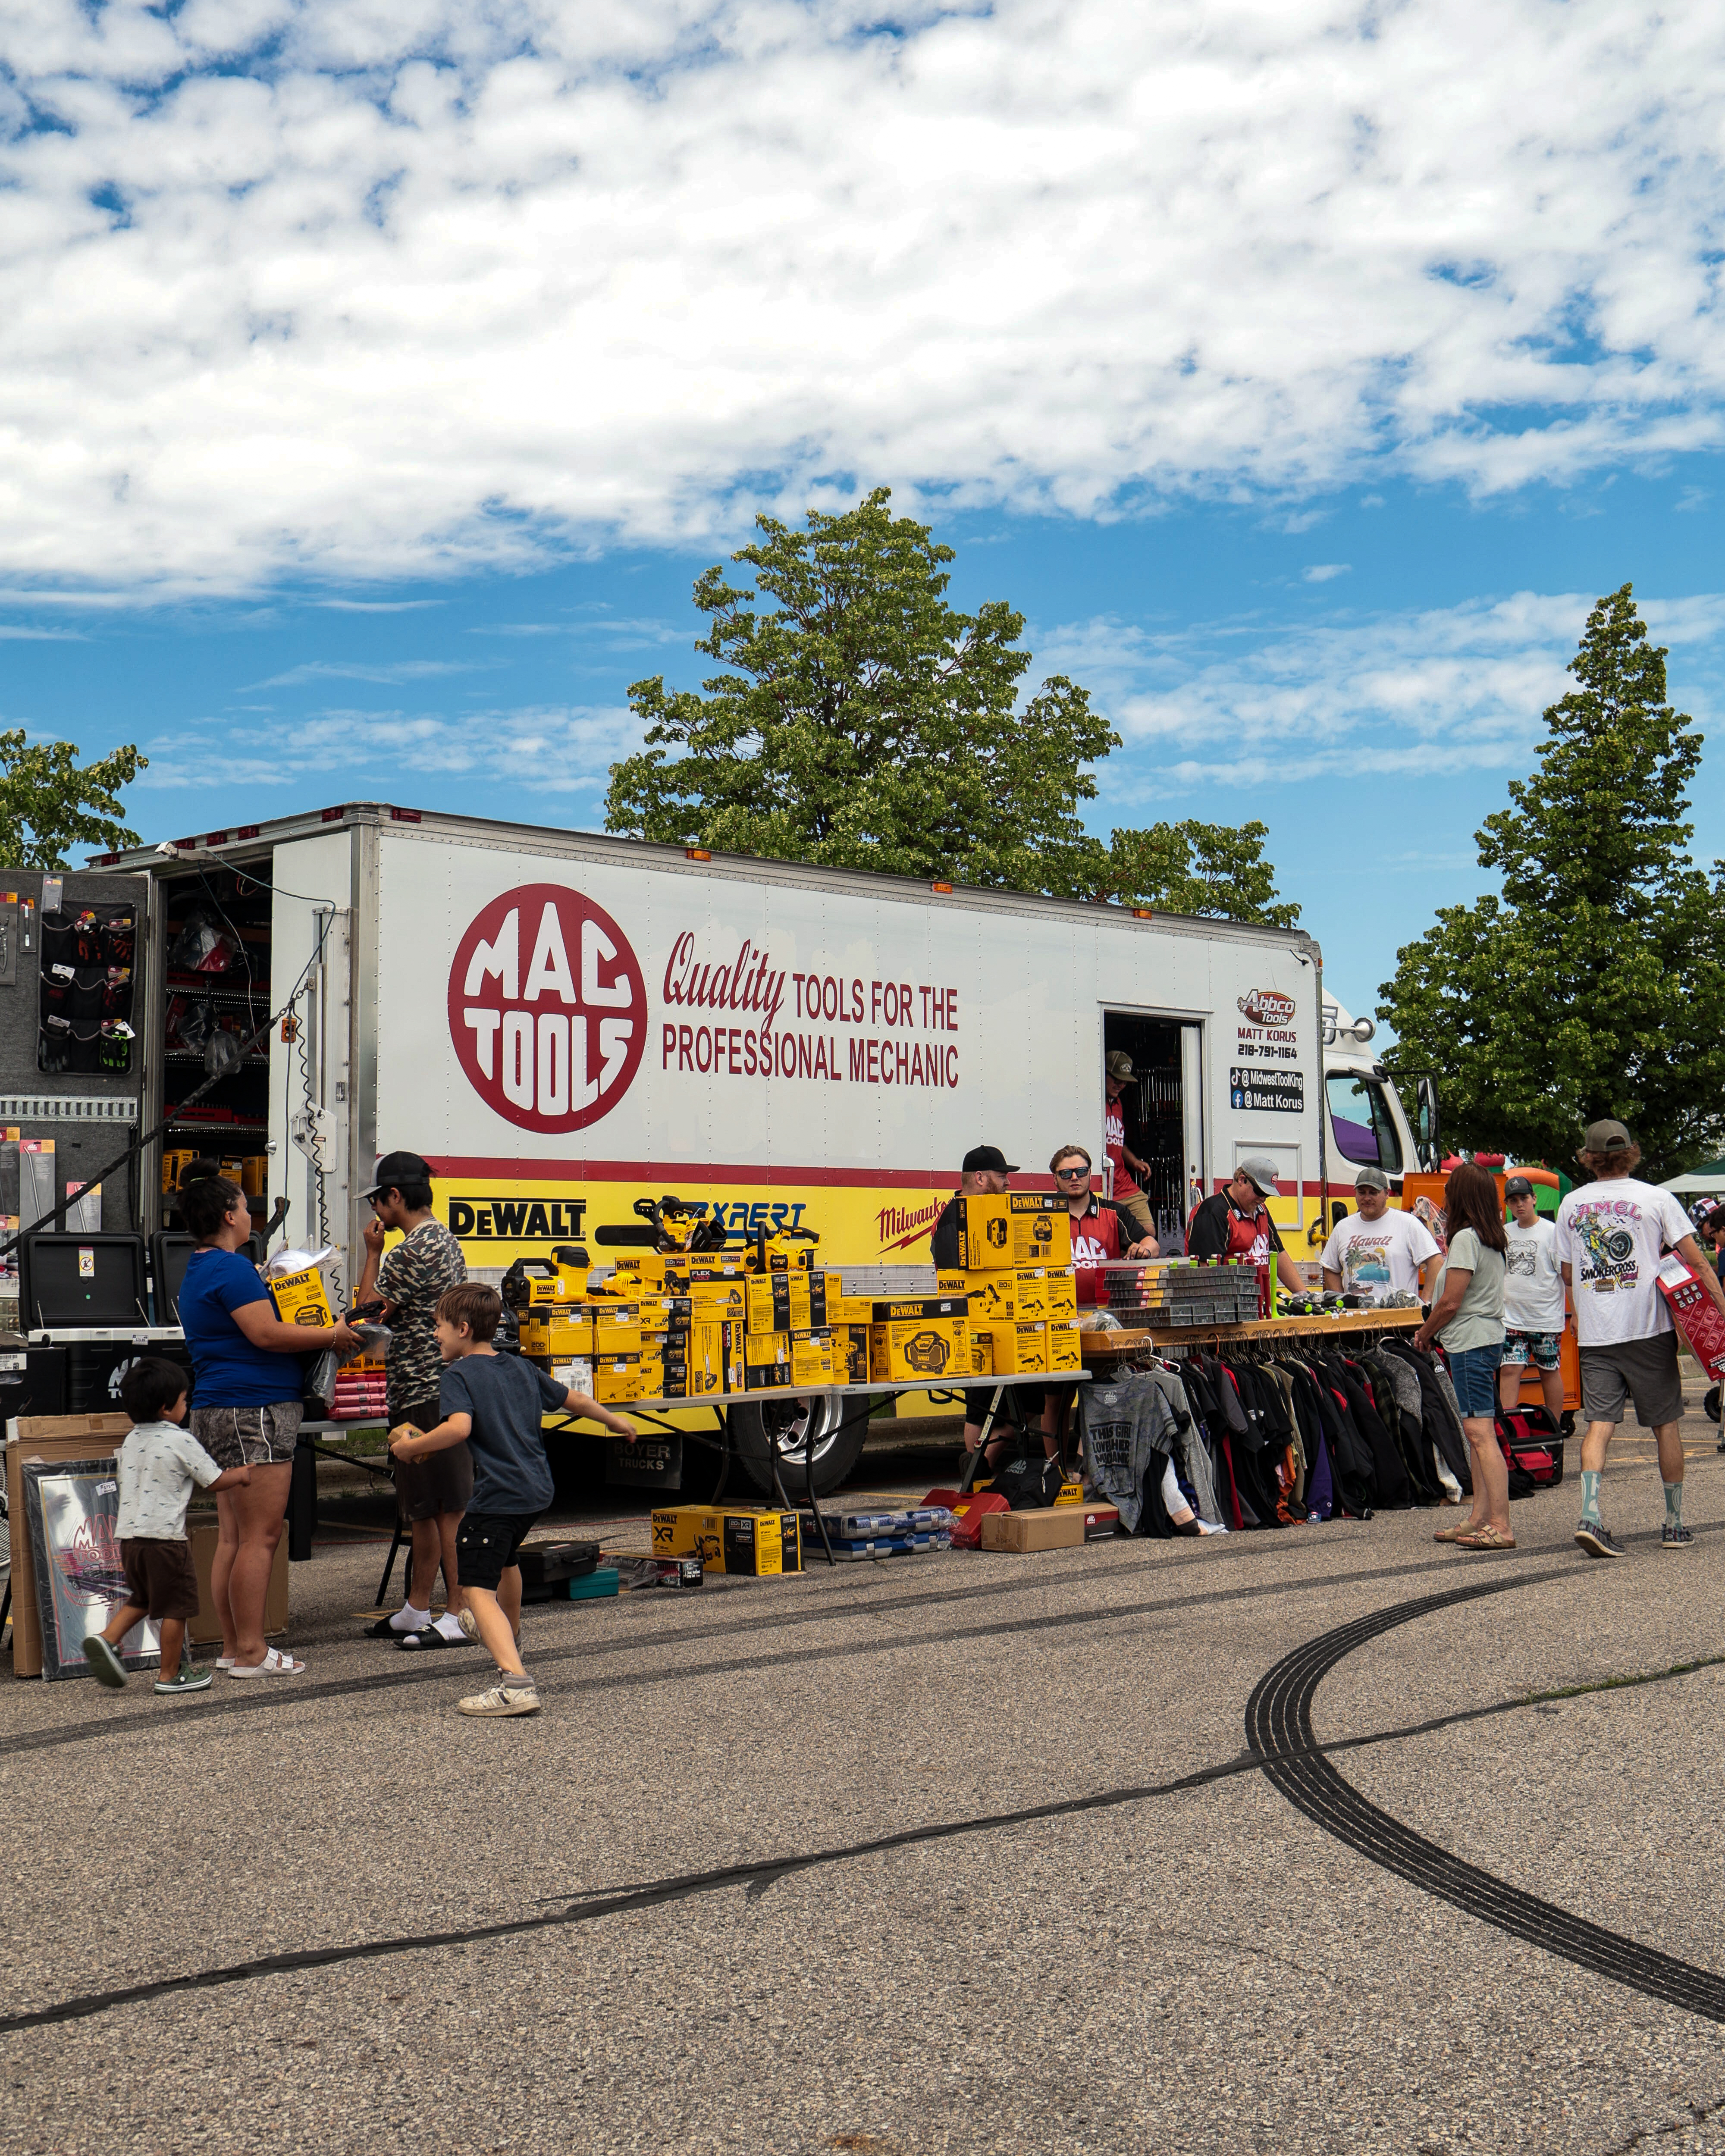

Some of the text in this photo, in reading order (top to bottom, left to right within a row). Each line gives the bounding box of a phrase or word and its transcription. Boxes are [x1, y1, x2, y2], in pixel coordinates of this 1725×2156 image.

[464, 902, 633, 1008] MAC
[662, 931, 958, 1037] Quality TOOLS FOR THE
[1239, 989, 1294, 1013] Abbco
[1261, 1011, 1288, 1024] Tools
[1237, 1027, 1297, 1043] MATT KORUS
[662, 1024, 959, 1089] PROFESSIONAL MECHANIC
[1238, 1044, 1297, 1059] 218-791-1164
[463, 1008, 633, 1116] TOOLS
[1242, 1070, 1302, 1091] @ MidwestToolKing
[1245, 1091, 1302, 1109] @ Matt Korus
[1106, 1138, 1124, 1147] OOLS
[874, 1197, 947, 1243] Milwauke
[1568, 1200, 1643, 1231] CAMEL
[1346, 1235, 1393, 1250] Hawaii
[1072, 1260, 1099, 1269] OOL
[1581, 1260, 1636, 1282] SMOKERCROSS
[1090, 1424, 1131, 1441] THIS GIRL
[615, 1443, 671, 1459] BOYER
[1092, 1438, 1130, 1454] LOVE HER
[618, 1457, 664, 1470] TRUCKS
[654, 1526, 674, 1542] XR
[74, 1546, 122, 1563] TOOL
